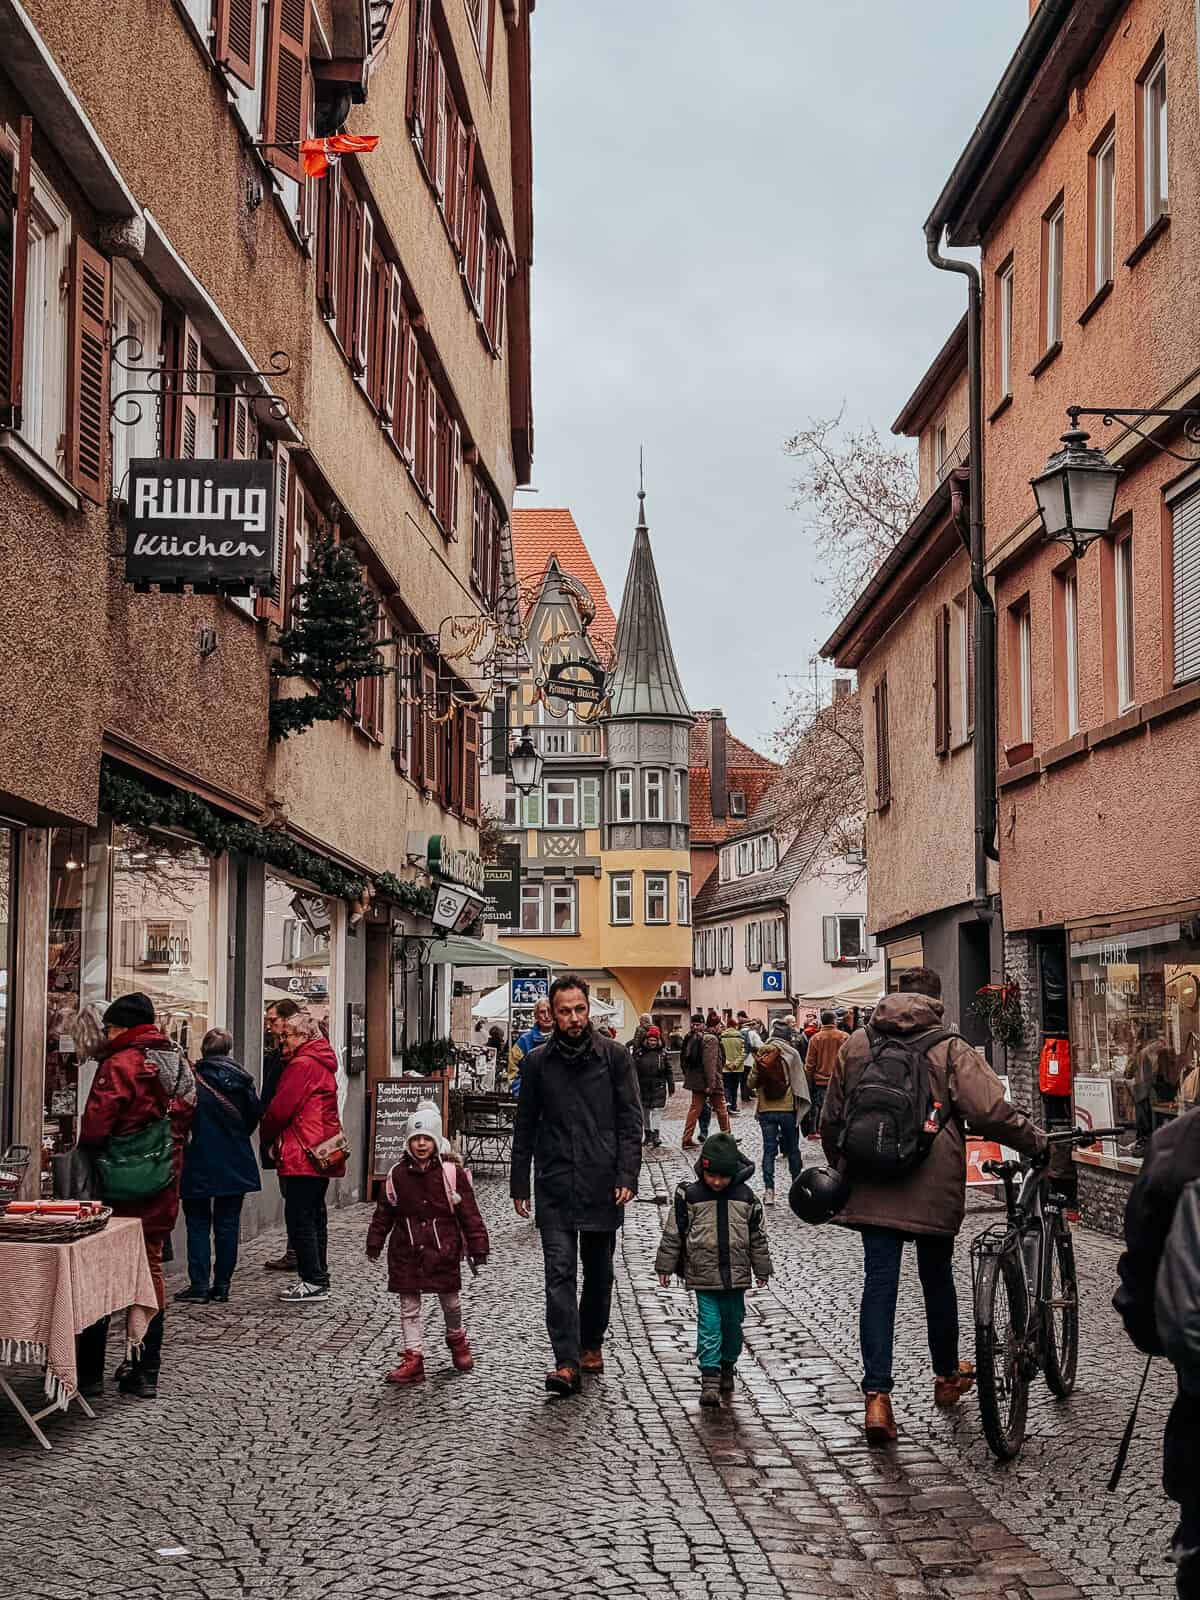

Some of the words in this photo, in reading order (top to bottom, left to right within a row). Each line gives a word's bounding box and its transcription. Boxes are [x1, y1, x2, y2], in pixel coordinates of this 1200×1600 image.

[135, 478, 266, 532] Rilling
[133, 533, 266, 556] Küchen
[1099, 943, 1128, 967] LEDER
[1094, 973, 1136, 996] Bouque
